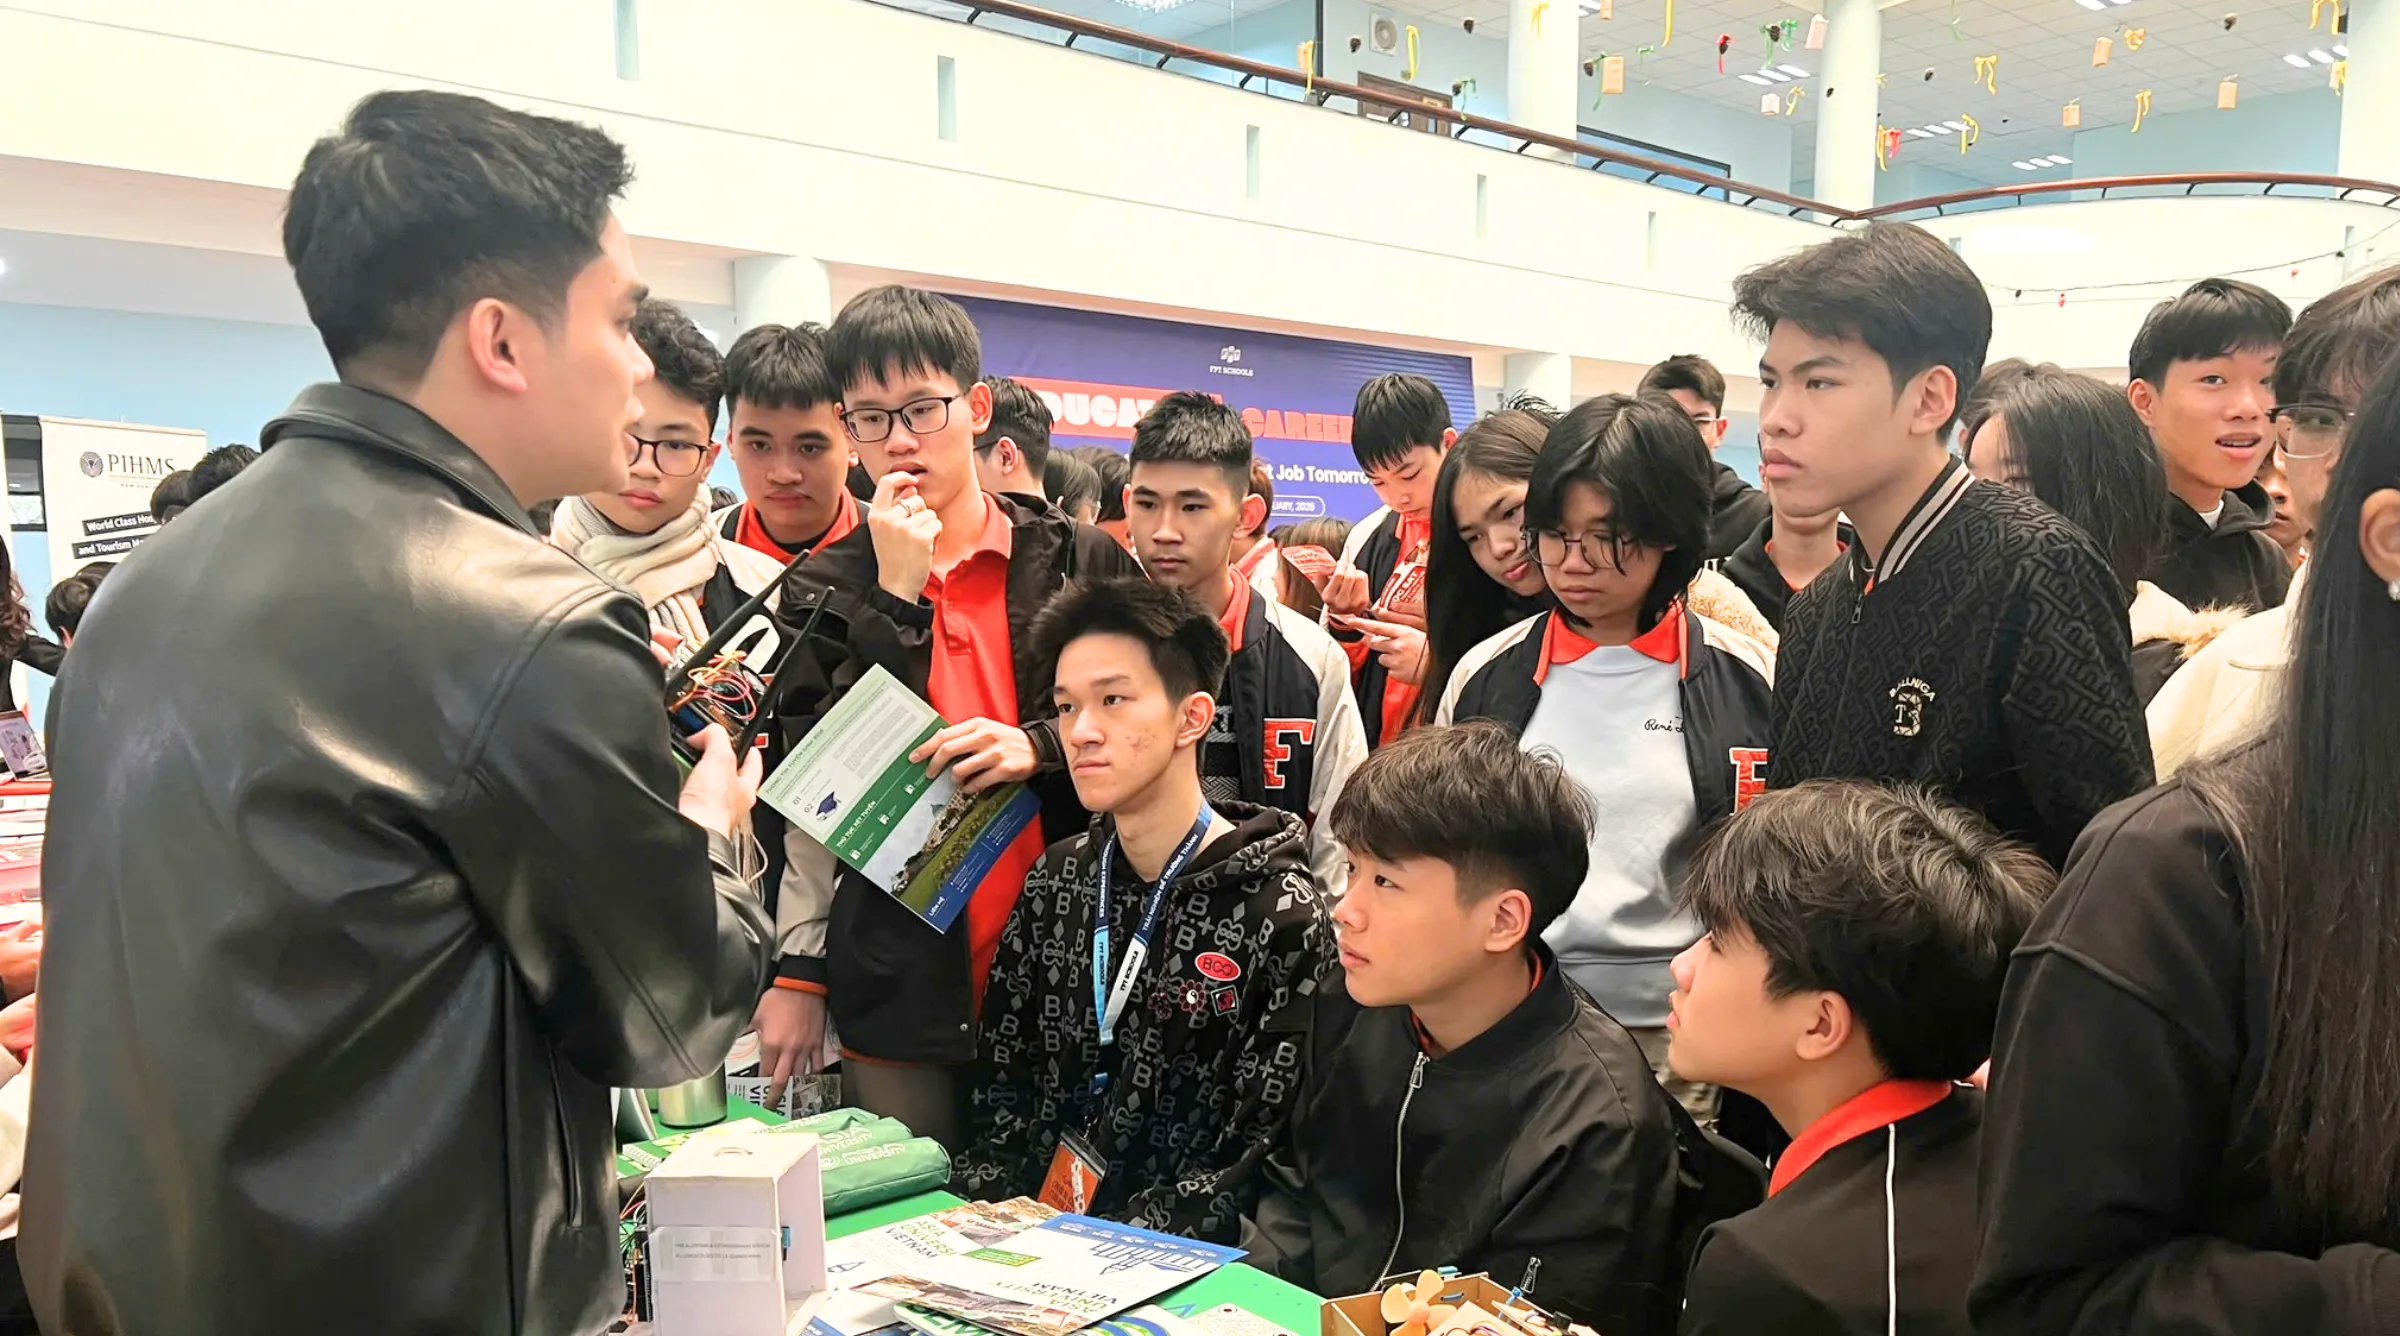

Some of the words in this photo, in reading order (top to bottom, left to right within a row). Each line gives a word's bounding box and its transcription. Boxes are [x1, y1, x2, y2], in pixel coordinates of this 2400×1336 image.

[1035, 391, 1158, 428] DUCAT
[107, 453, 176, 476] PIHMS
[1276, 464, 1304, 481] Job
[1305, 466, 1372, 485] Tomorro
[87, 520, 114, 532] World
[114, 517, 137, 527] Class
[78, 545, 95, 555] and
[96, 540, 132, 553] Tourism
[885, 1228, 939, 1260] VIETNAM
[901, 1224, 957, 1256] UNIVERSI
[1031, 1281, 1118, 1304] VIETNAM
